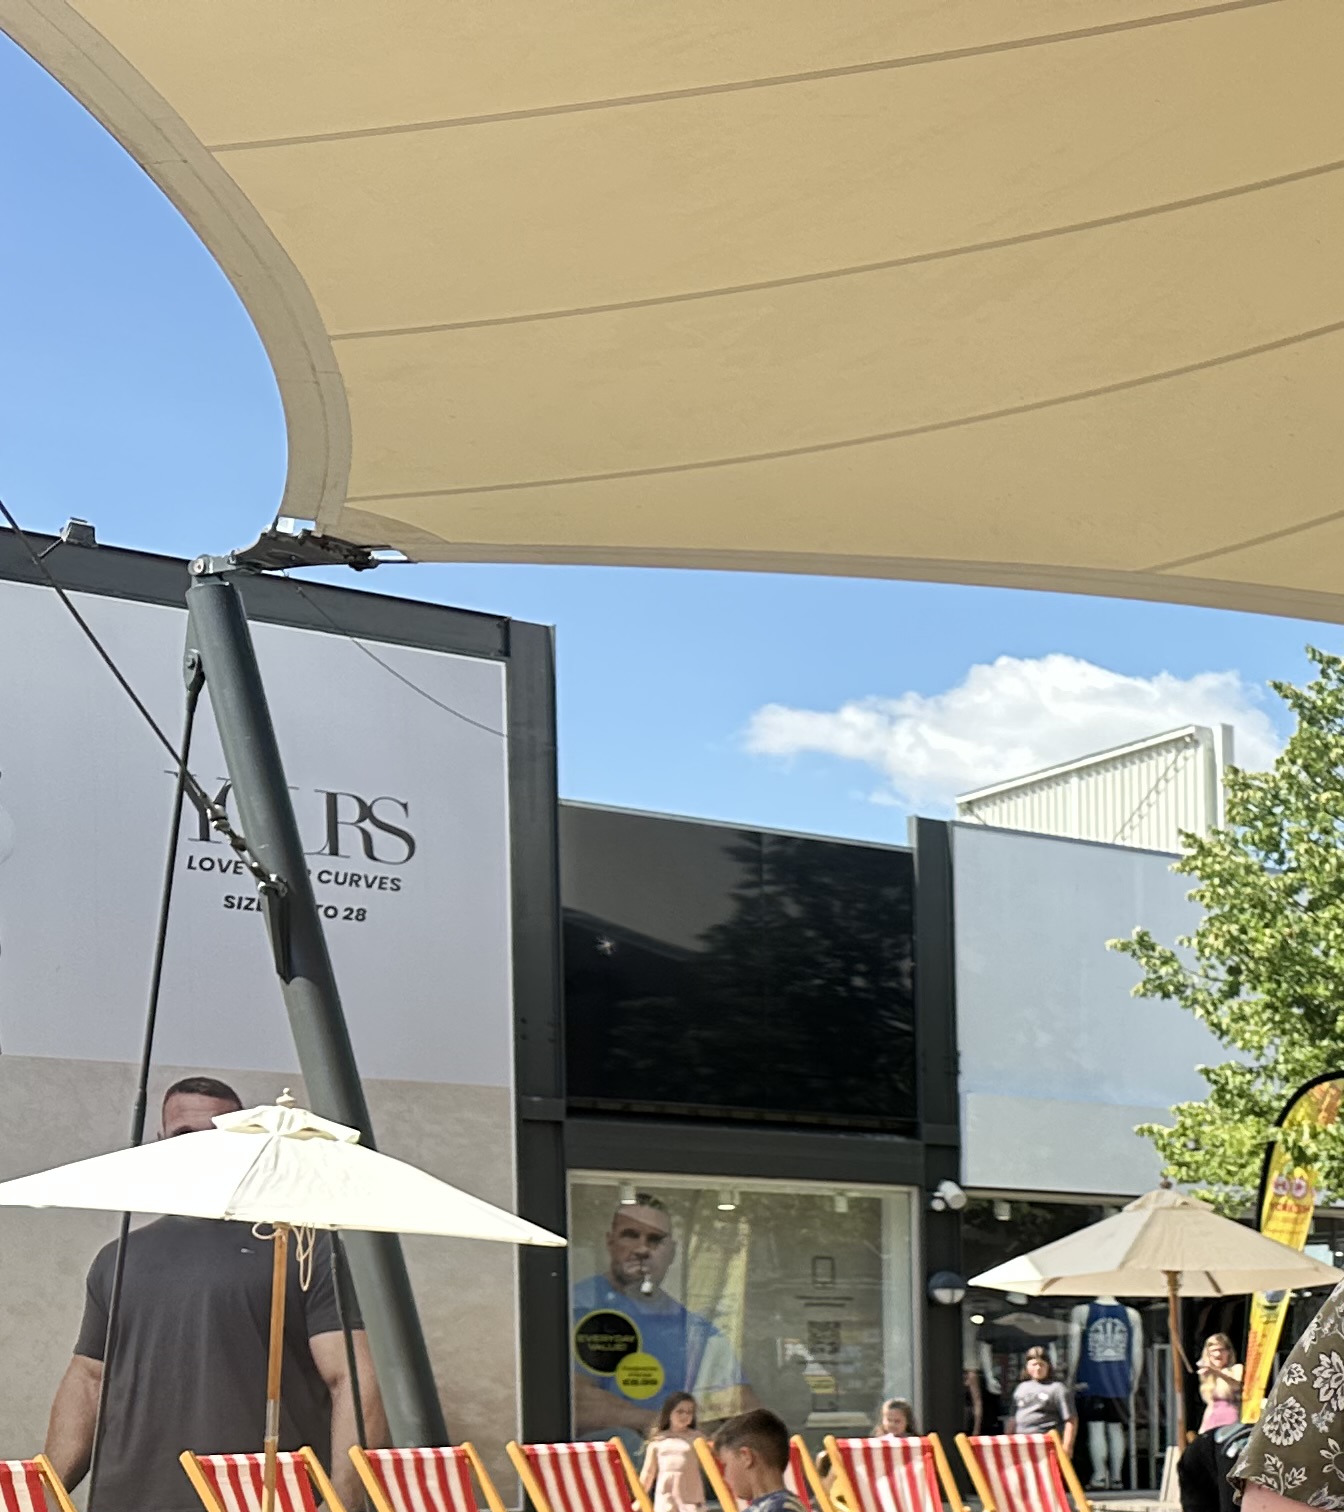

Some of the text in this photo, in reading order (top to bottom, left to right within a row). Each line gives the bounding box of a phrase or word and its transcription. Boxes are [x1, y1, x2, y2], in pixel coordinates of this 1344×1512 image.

[187, 855, 243, 875] LOVE
[317, 869, 402, 892] CURVES
[342, 906, 367, 922] 28
